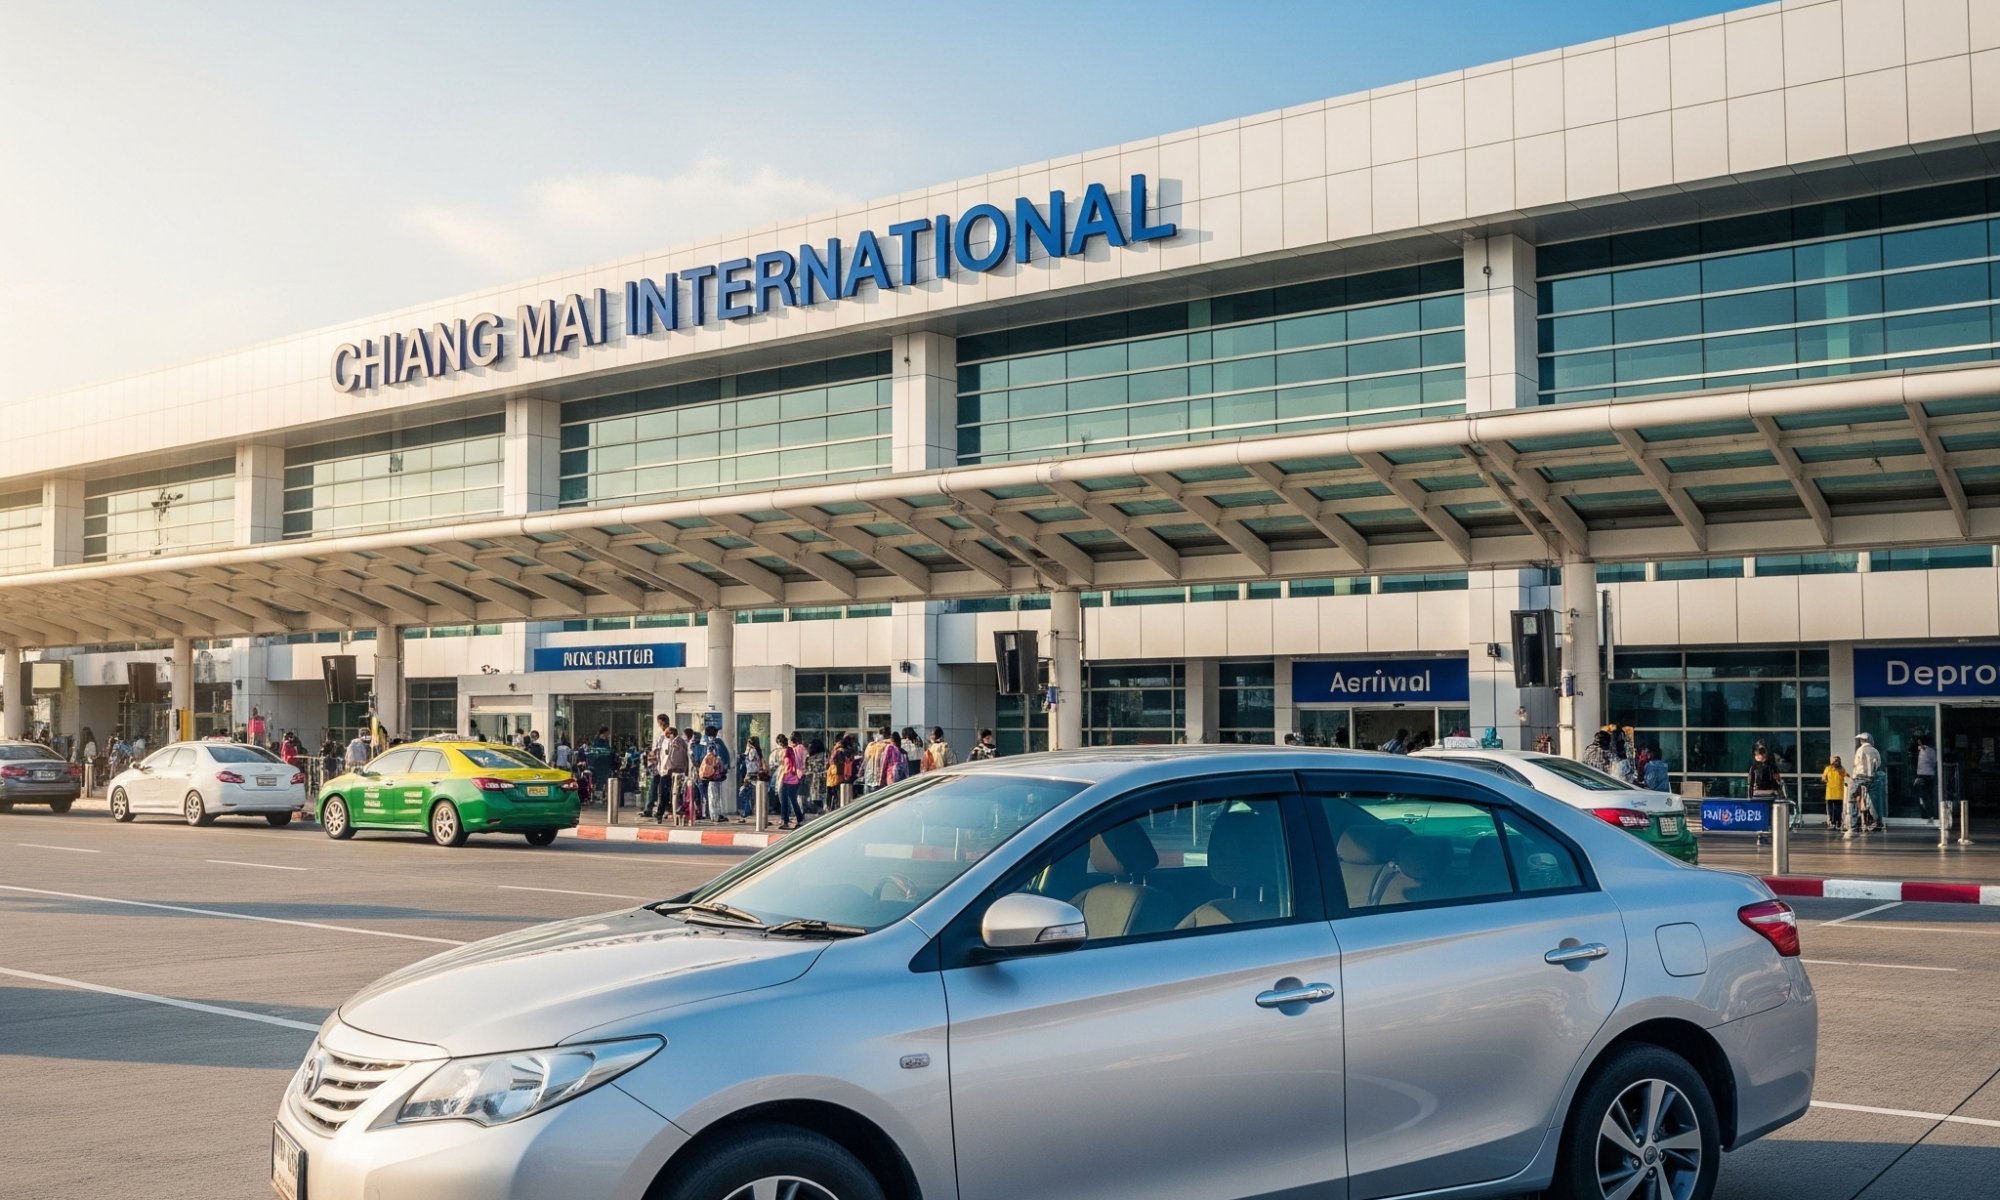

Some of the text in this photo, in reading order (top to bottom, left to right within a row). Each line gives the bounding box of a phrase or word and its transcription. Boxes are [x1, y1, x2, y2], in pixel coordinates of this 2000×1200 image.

[330, 174, 1177, 393] CHIANG MAI INTERNATIONAL
[1886, 660, 2000, 692] Depro
